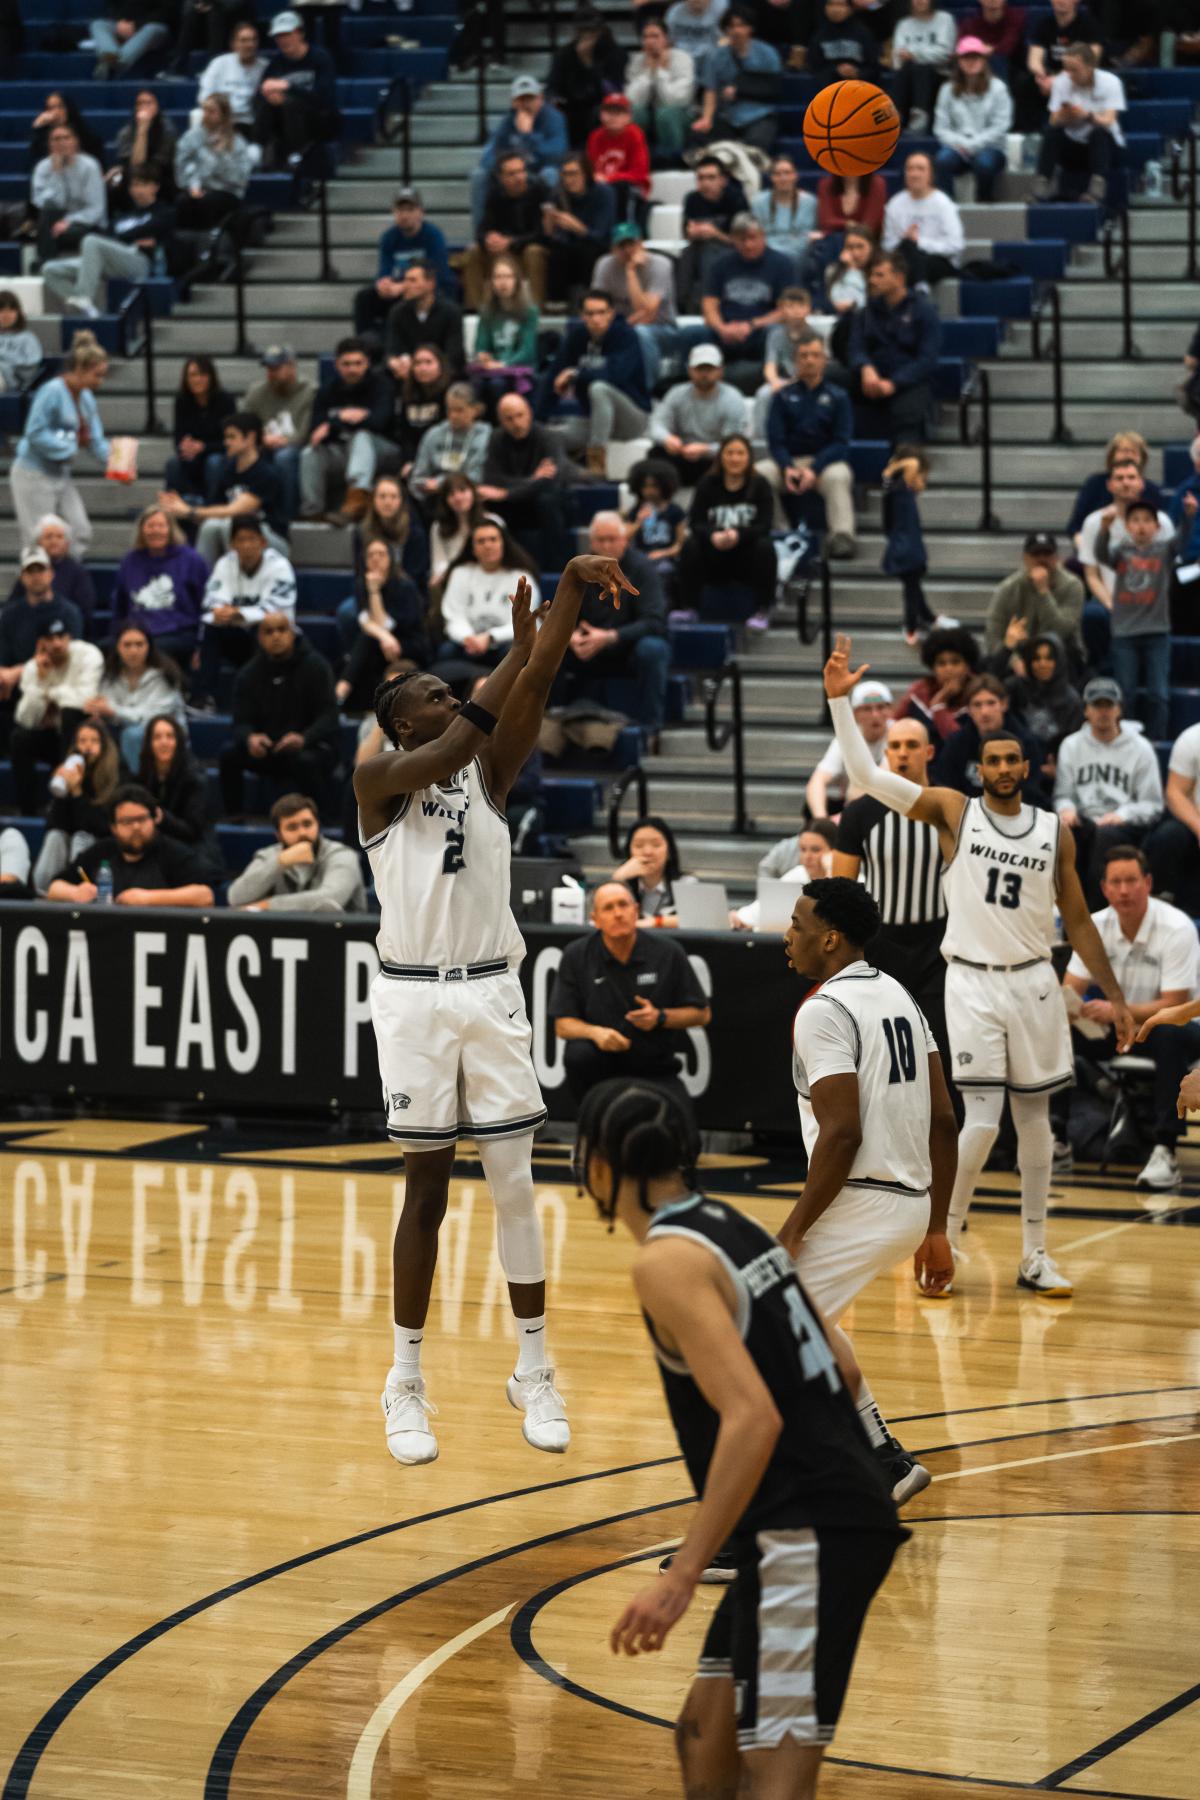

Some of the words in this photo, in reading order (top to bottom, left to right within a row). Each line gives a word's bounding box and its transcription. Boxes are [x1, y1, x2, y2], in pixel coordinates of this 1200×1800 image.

[1076, 763, 1129, 795] UNH
[442, 827, 467, 875] 2
[969, 843, 1047, 873] WILDCATS
[984, 866, 1023, 910] 13
[0, 925, 98, 1065] CA
[133, 931, 309, 1076] EAST
[881, 1015, 917, 1085] 10
